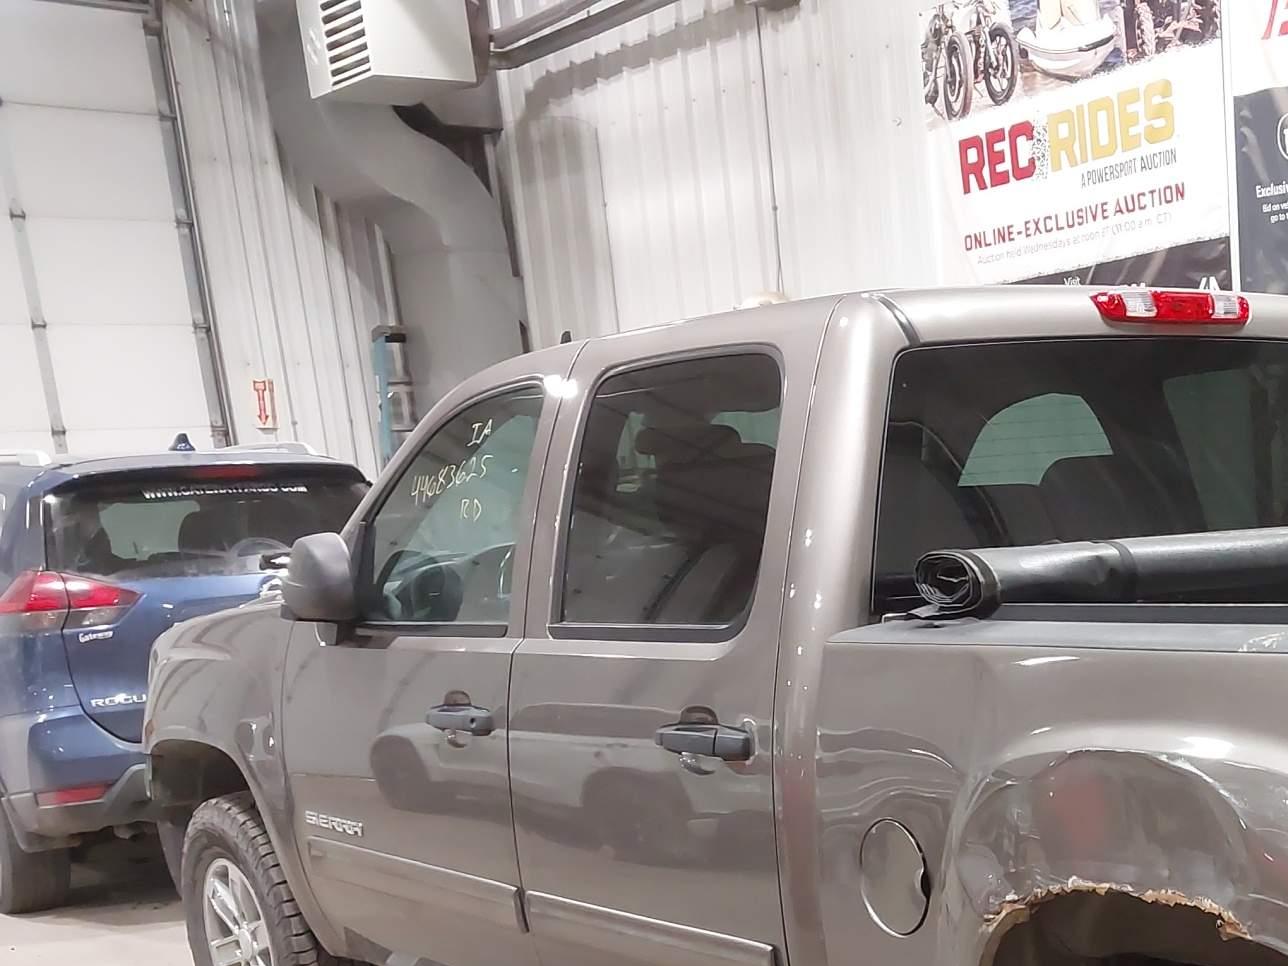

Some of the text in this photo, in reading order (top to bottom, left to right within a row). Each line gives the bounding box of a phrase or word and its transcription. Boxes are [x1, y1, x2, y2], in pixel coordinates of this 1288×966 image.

[958, 79, 1176, 195] REC RIDES
[1087, 158, 1137, 186] POWERSPORT
[1140, 147, 1177, 172] AUCTION
[964, 182, 1186, 251] ONLINE-EXCLUSIVE AUCTION
[1064, 276, 1082, 287] Visit
[411, 455, 494, 505] 44683625
[90, 693, 147, 707] ROGU
[305, 810, 363, 837] SIERRA
